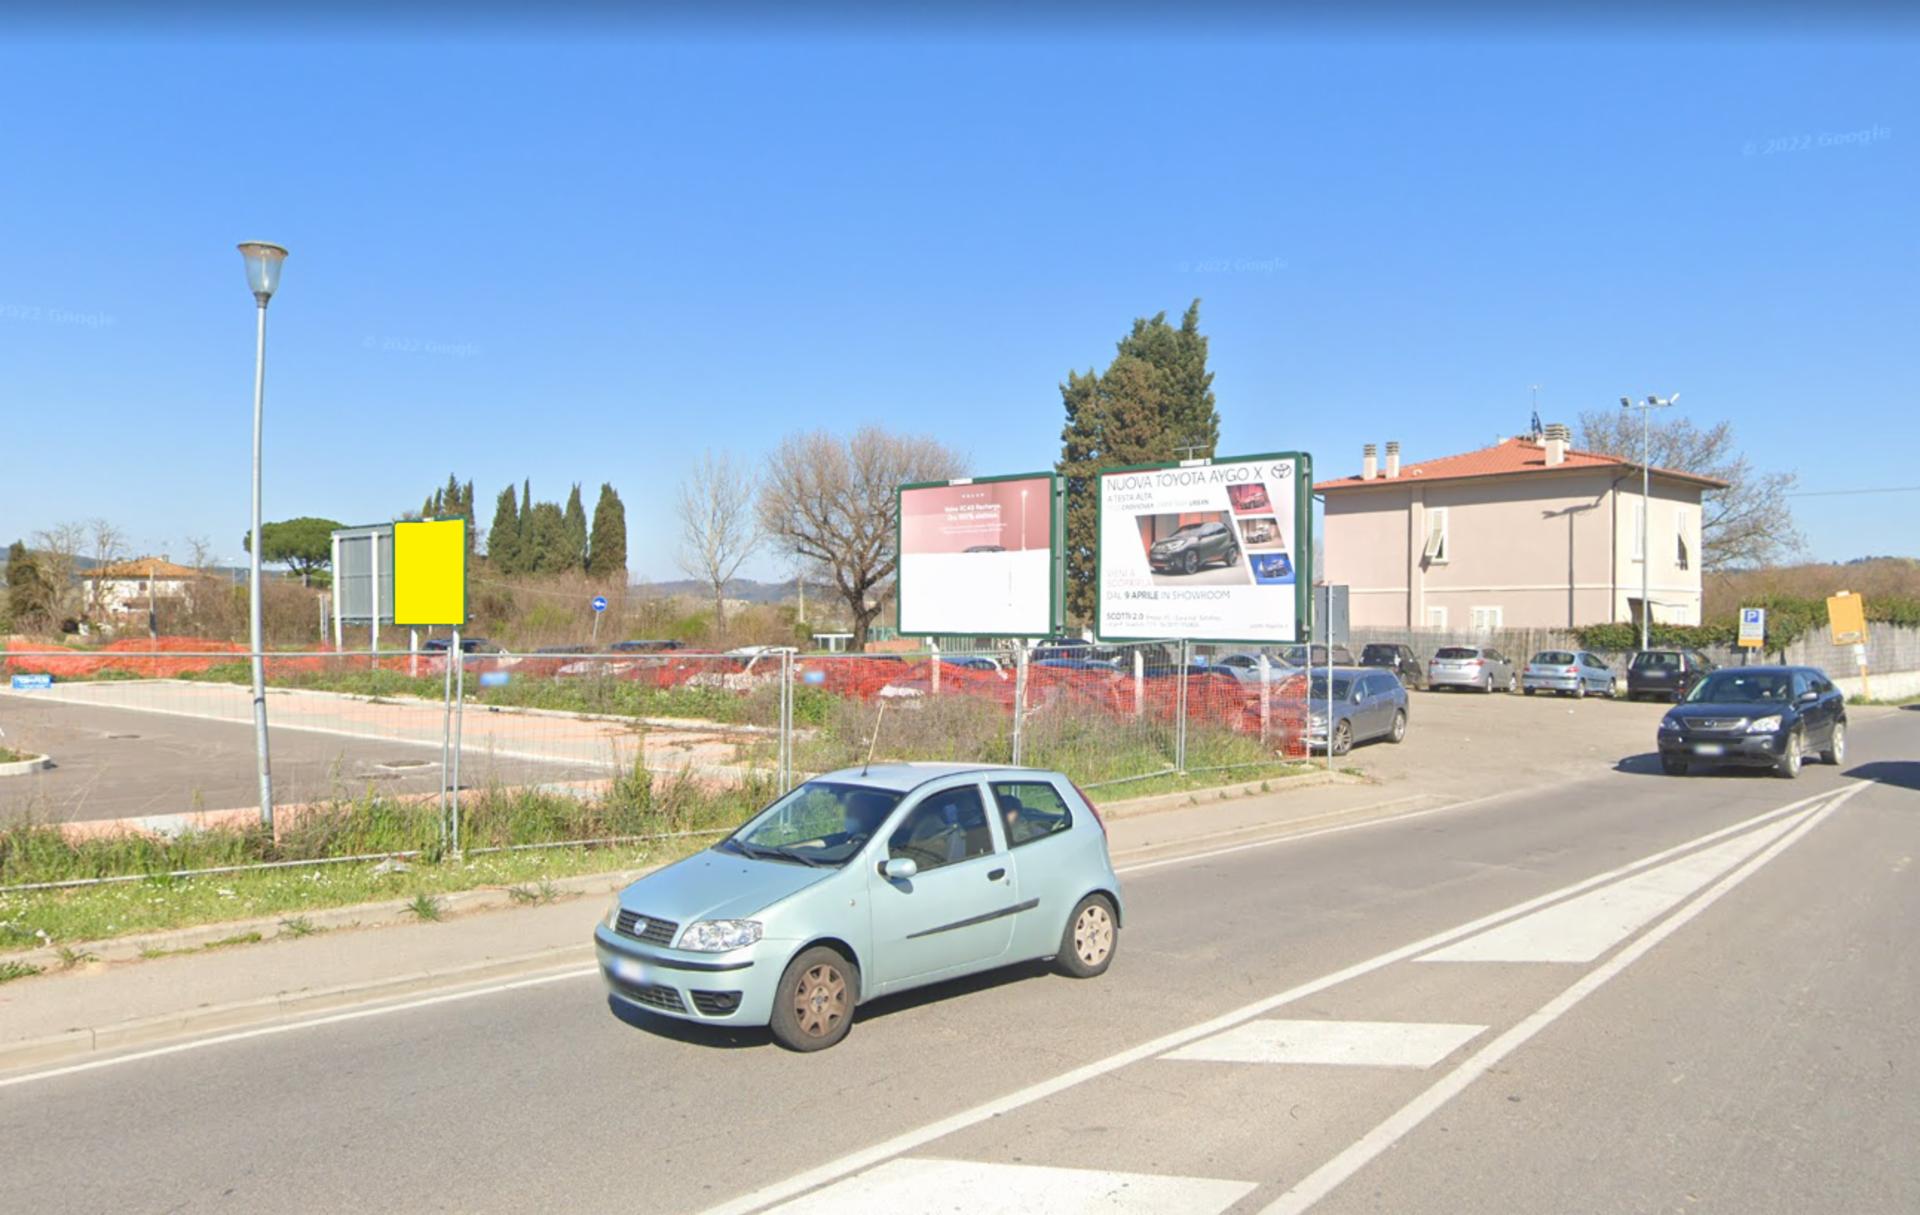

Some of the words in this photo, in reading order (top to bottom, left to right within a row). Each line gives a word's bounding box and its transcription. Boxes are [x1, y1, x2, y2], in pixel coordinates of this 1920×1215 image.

[1107, 475, 1153, 491] NUOVA
[1155, 471, 1207, 488] TOYOTA
[1209, 467, 1250, 484] AYGO
[1252, 466, 1264, 481] X
[1114, 493, 1136, 502] TESTA
[1135, 491, 1153, 501] ALTA
[1124, 591, 1130, 600] 9
[1131, 590, 1159, 600] APRILE
[1161, 590, 1171, 600] IN
[1172, 590, 1231, 600] SHOWROOM
